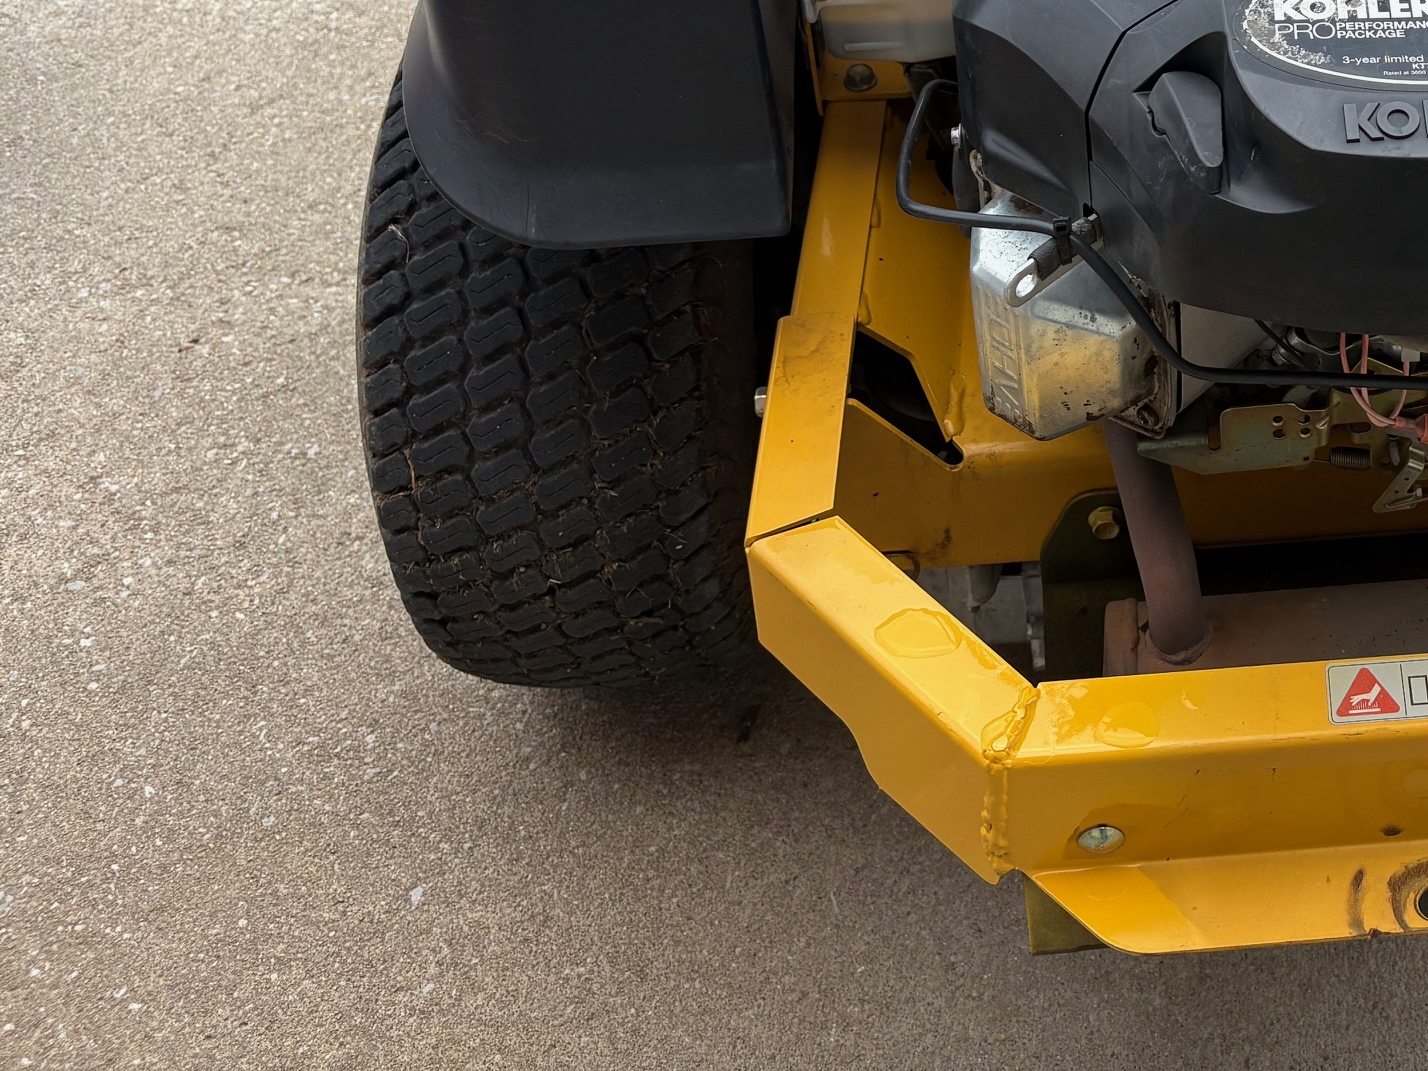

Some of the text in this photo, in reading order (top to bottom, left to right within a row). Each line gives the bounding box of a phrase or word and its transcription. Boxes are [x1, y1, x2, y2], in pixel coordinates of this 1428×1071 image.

[1274, 21, 1336, 40] PRO
[1336, 29, 1406, 39] PACKAGE
[1342, 55, 1381, 65] 3-year
[1384, 54, 1424, 63] limited
